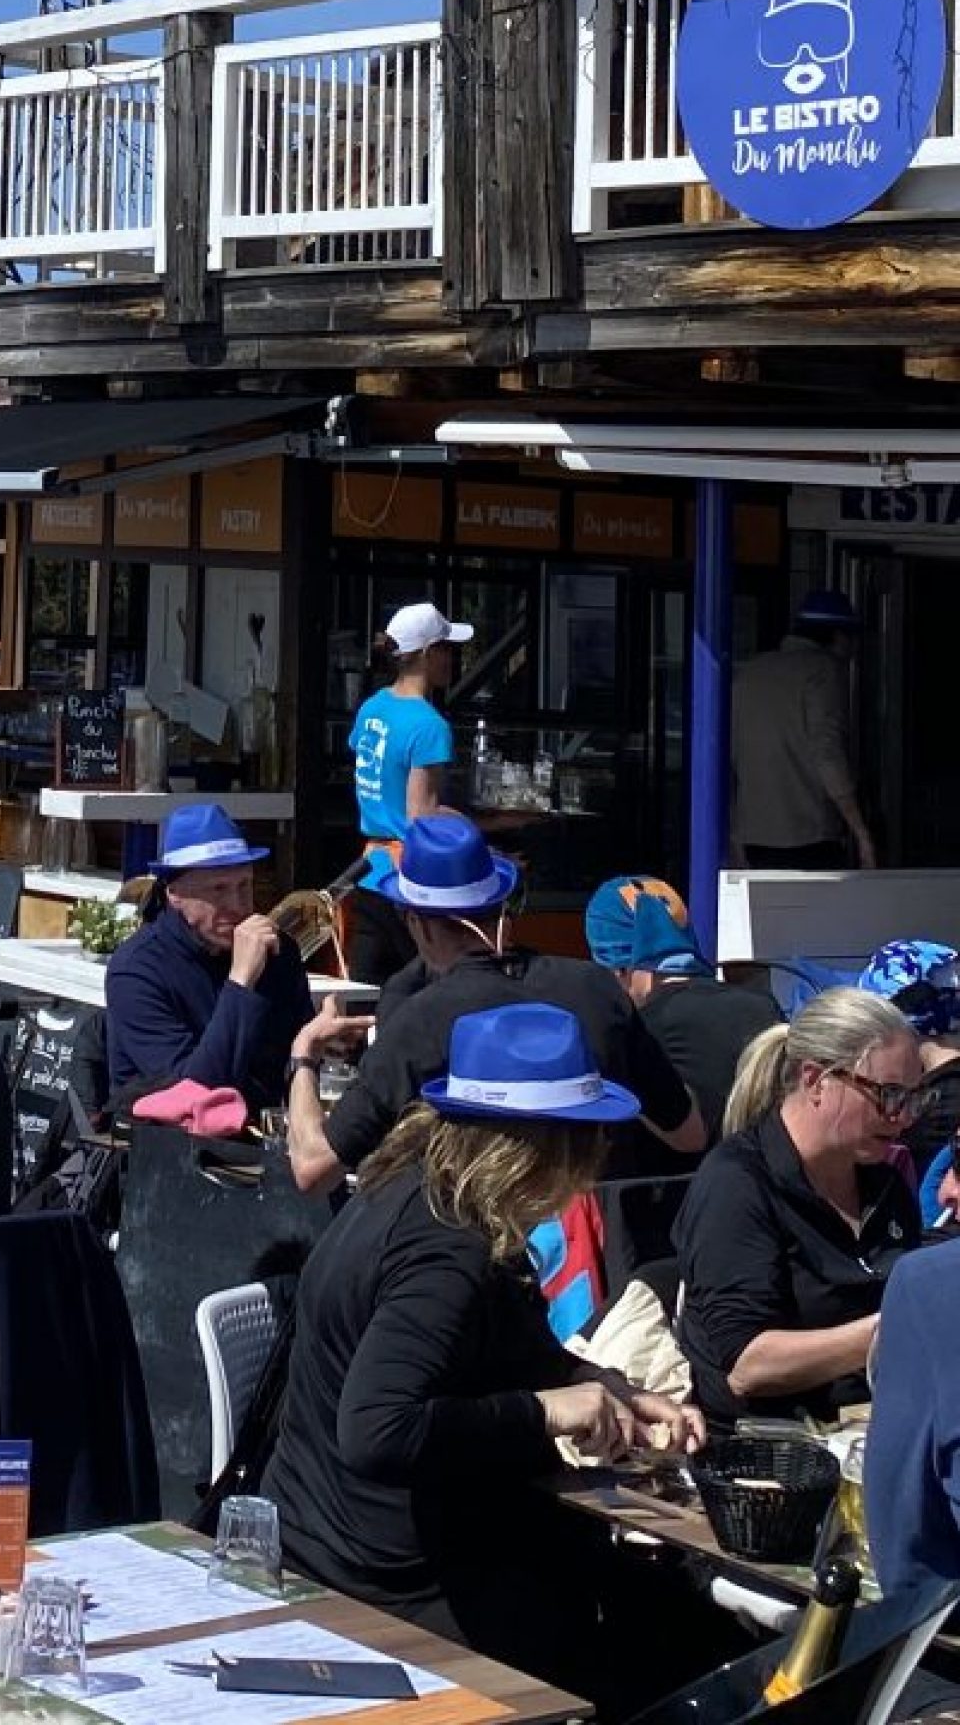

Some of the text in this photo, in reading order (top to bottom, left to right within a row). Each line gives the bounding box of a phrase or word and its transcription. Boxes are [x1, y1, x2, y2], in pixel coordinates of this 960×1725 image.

[733, 95, 880, 135] LE BISTRO
[732, 124, 881, 175] Du Monchu
